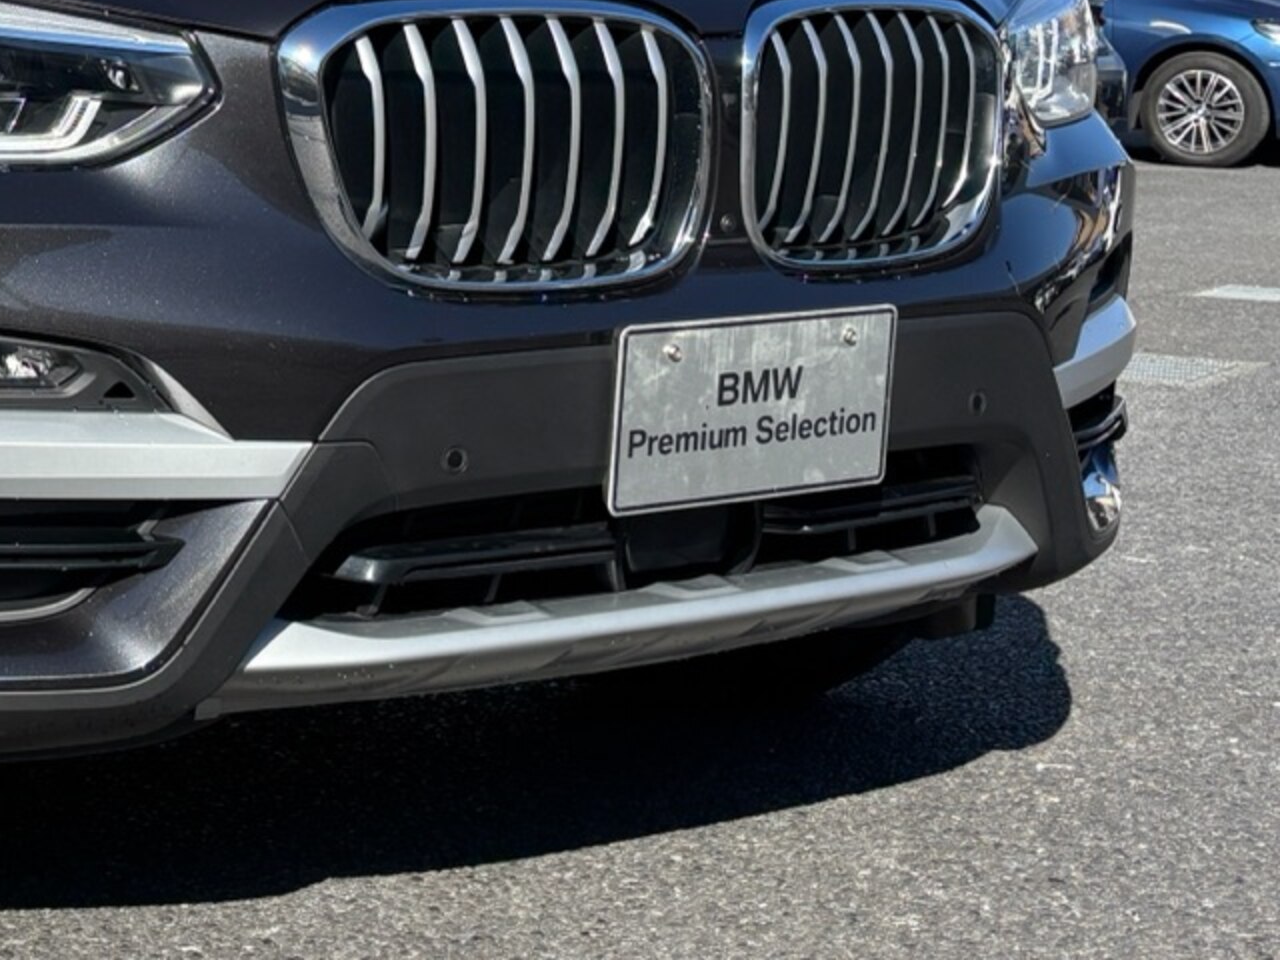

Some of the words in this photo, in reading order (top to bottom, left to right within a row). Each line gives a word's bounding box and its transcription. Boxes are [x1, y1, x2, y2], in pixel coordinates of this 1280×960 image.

[717, 365, 804, 407] BMW
[627, 422, 747, 458] Premium
[755, 407, 876, 445] Selection
